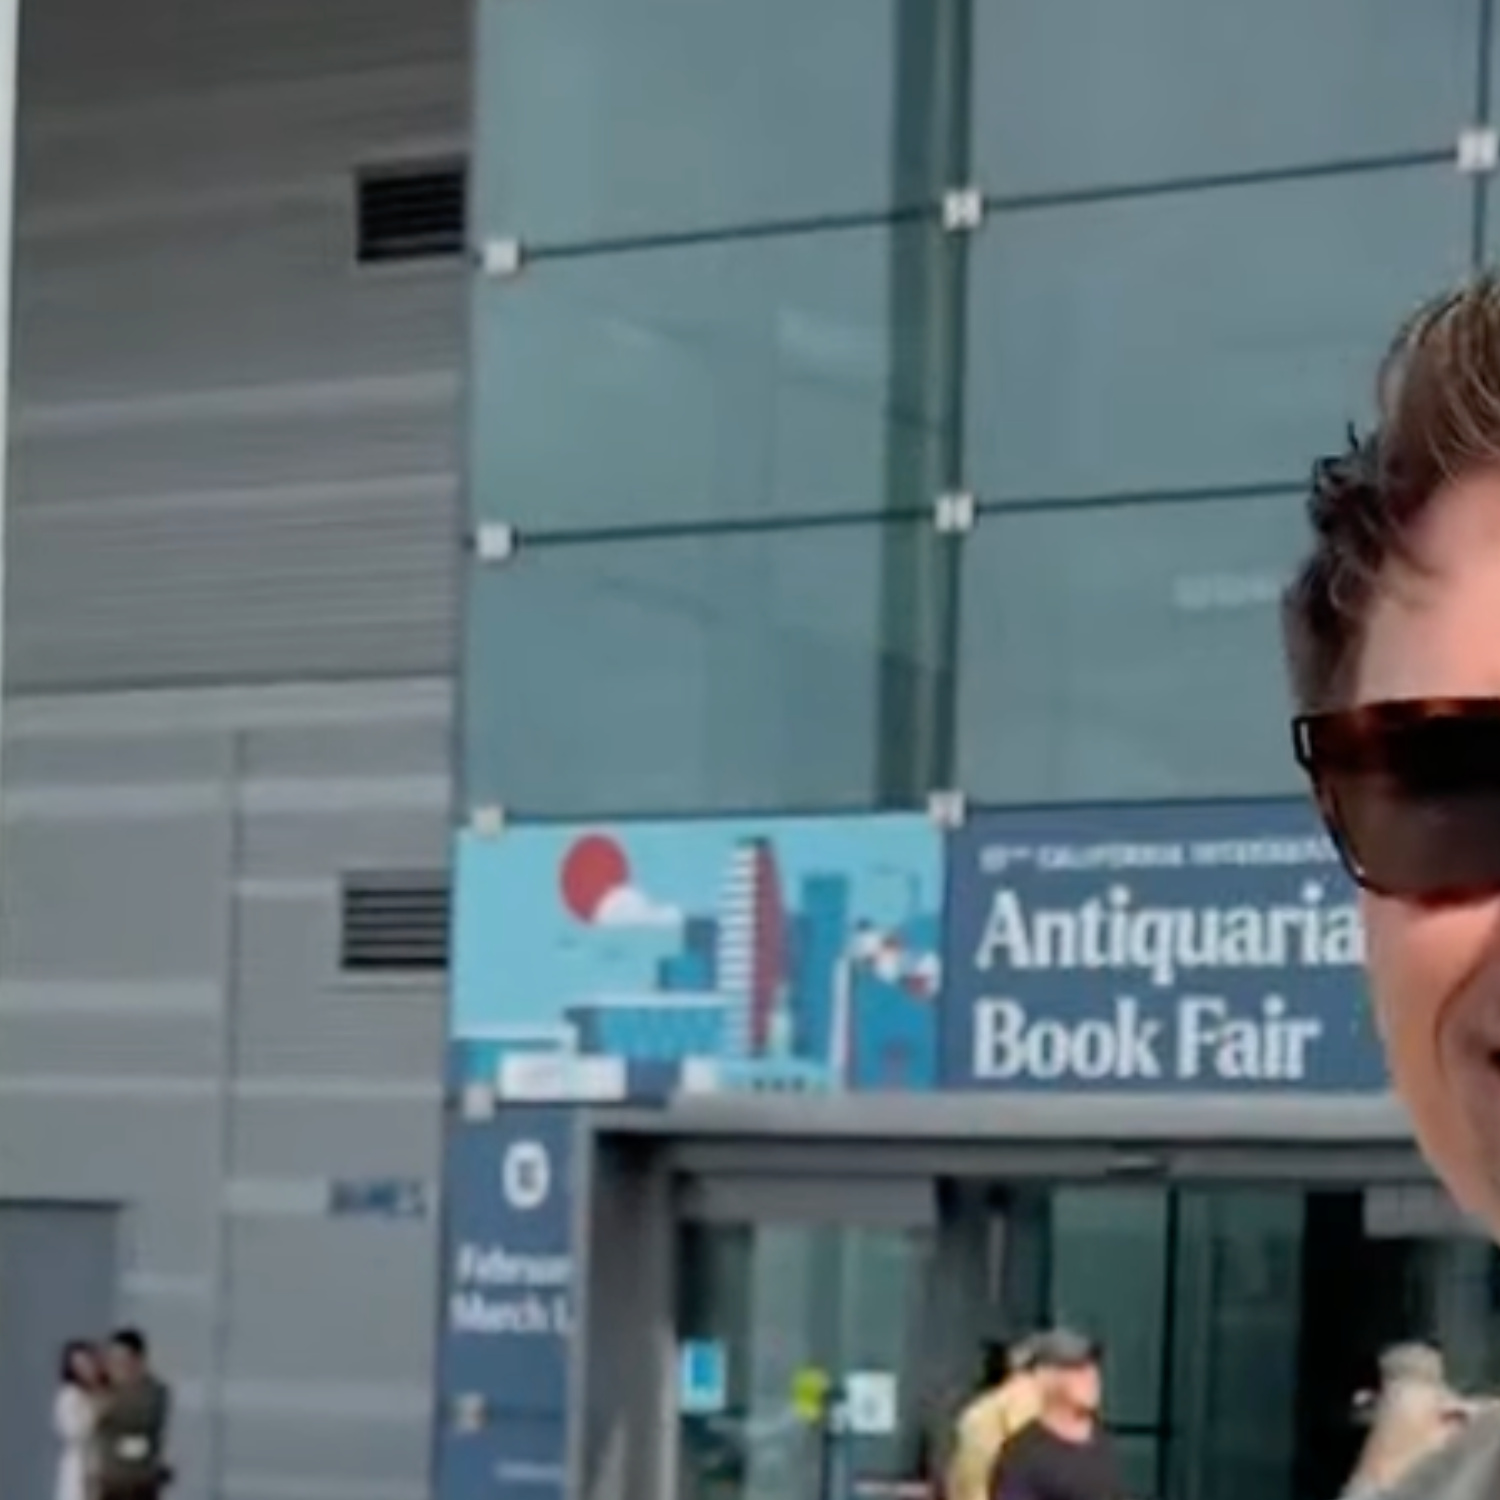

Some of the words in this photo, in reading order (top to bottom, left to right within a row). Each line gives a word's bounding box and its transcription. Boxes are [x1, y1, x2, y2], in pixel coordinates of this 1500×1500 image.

[975, 884, 1366, 986] Antiquaria
[973, 996, 1162, 1080] Book
[1177, 996, 1323, 1080] Fair
[450, 1293, 549, 1332] March
